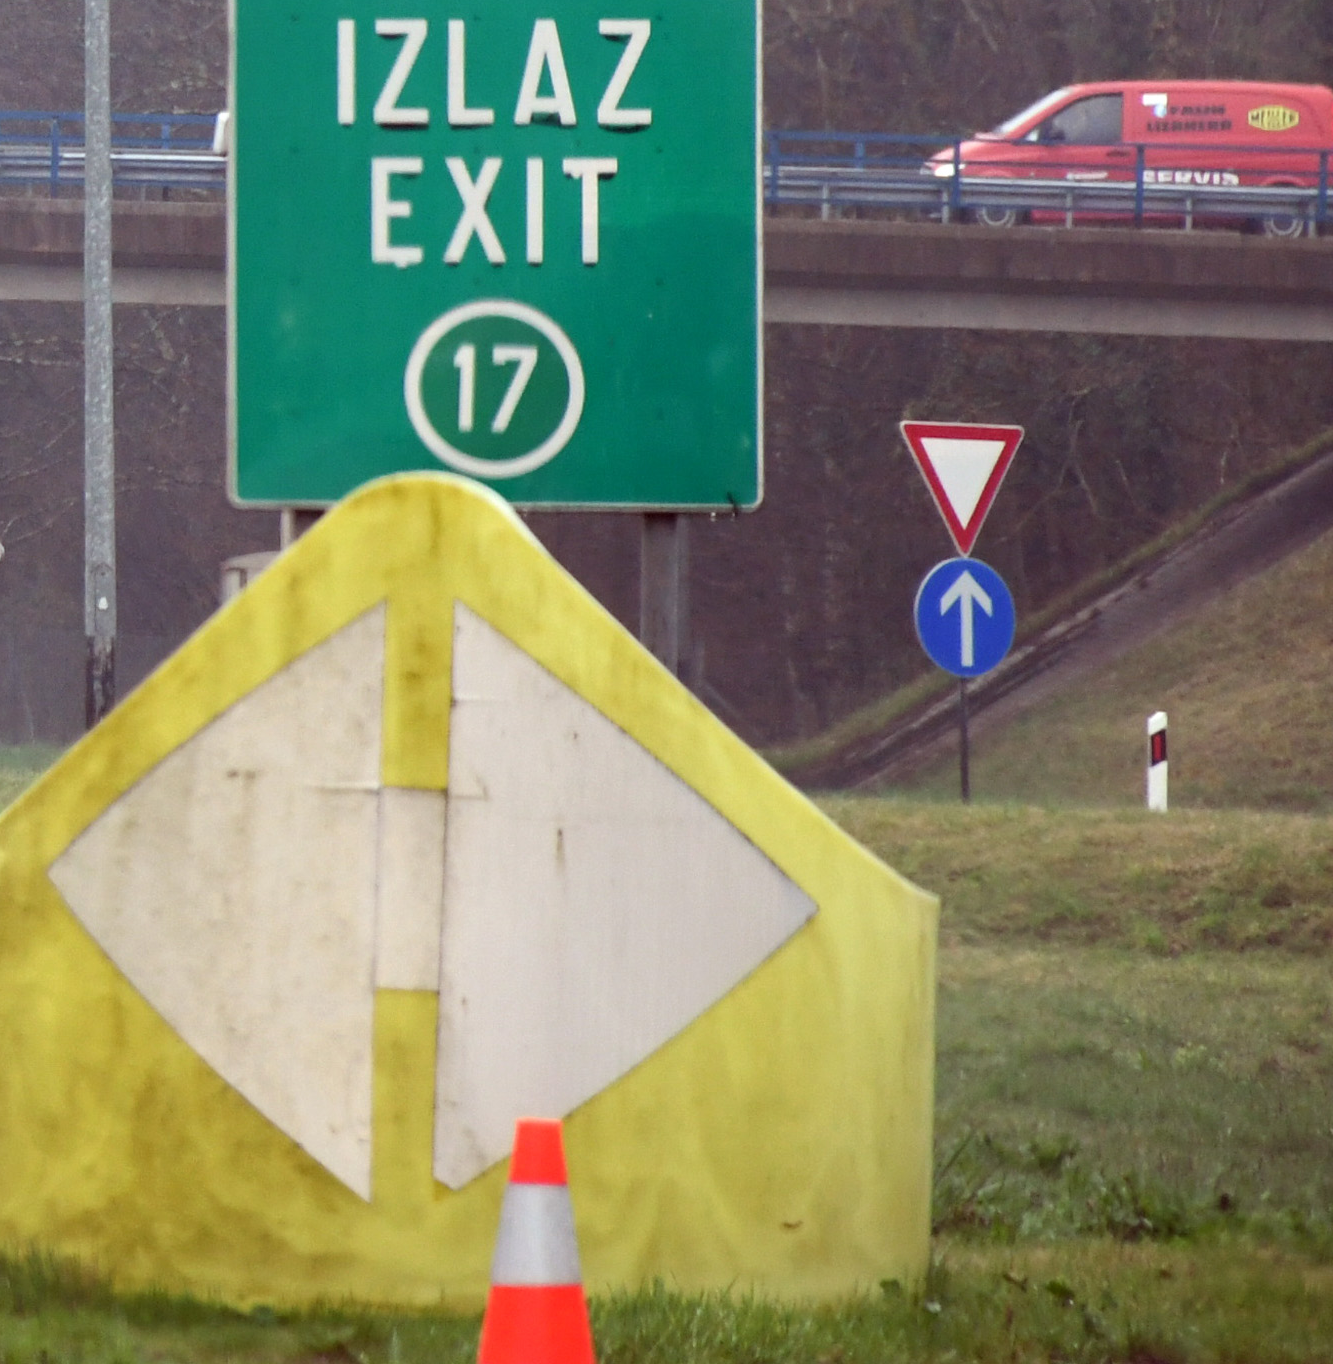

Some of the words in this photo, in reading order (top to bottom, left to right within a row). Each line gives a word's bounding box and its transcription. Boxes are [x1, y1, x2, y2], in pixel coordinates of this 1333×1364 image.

[337, 18, 652, 125] IZLAZ
[371, 156, 618, 267] EXIT
[453, 344, 538, 433] 17
